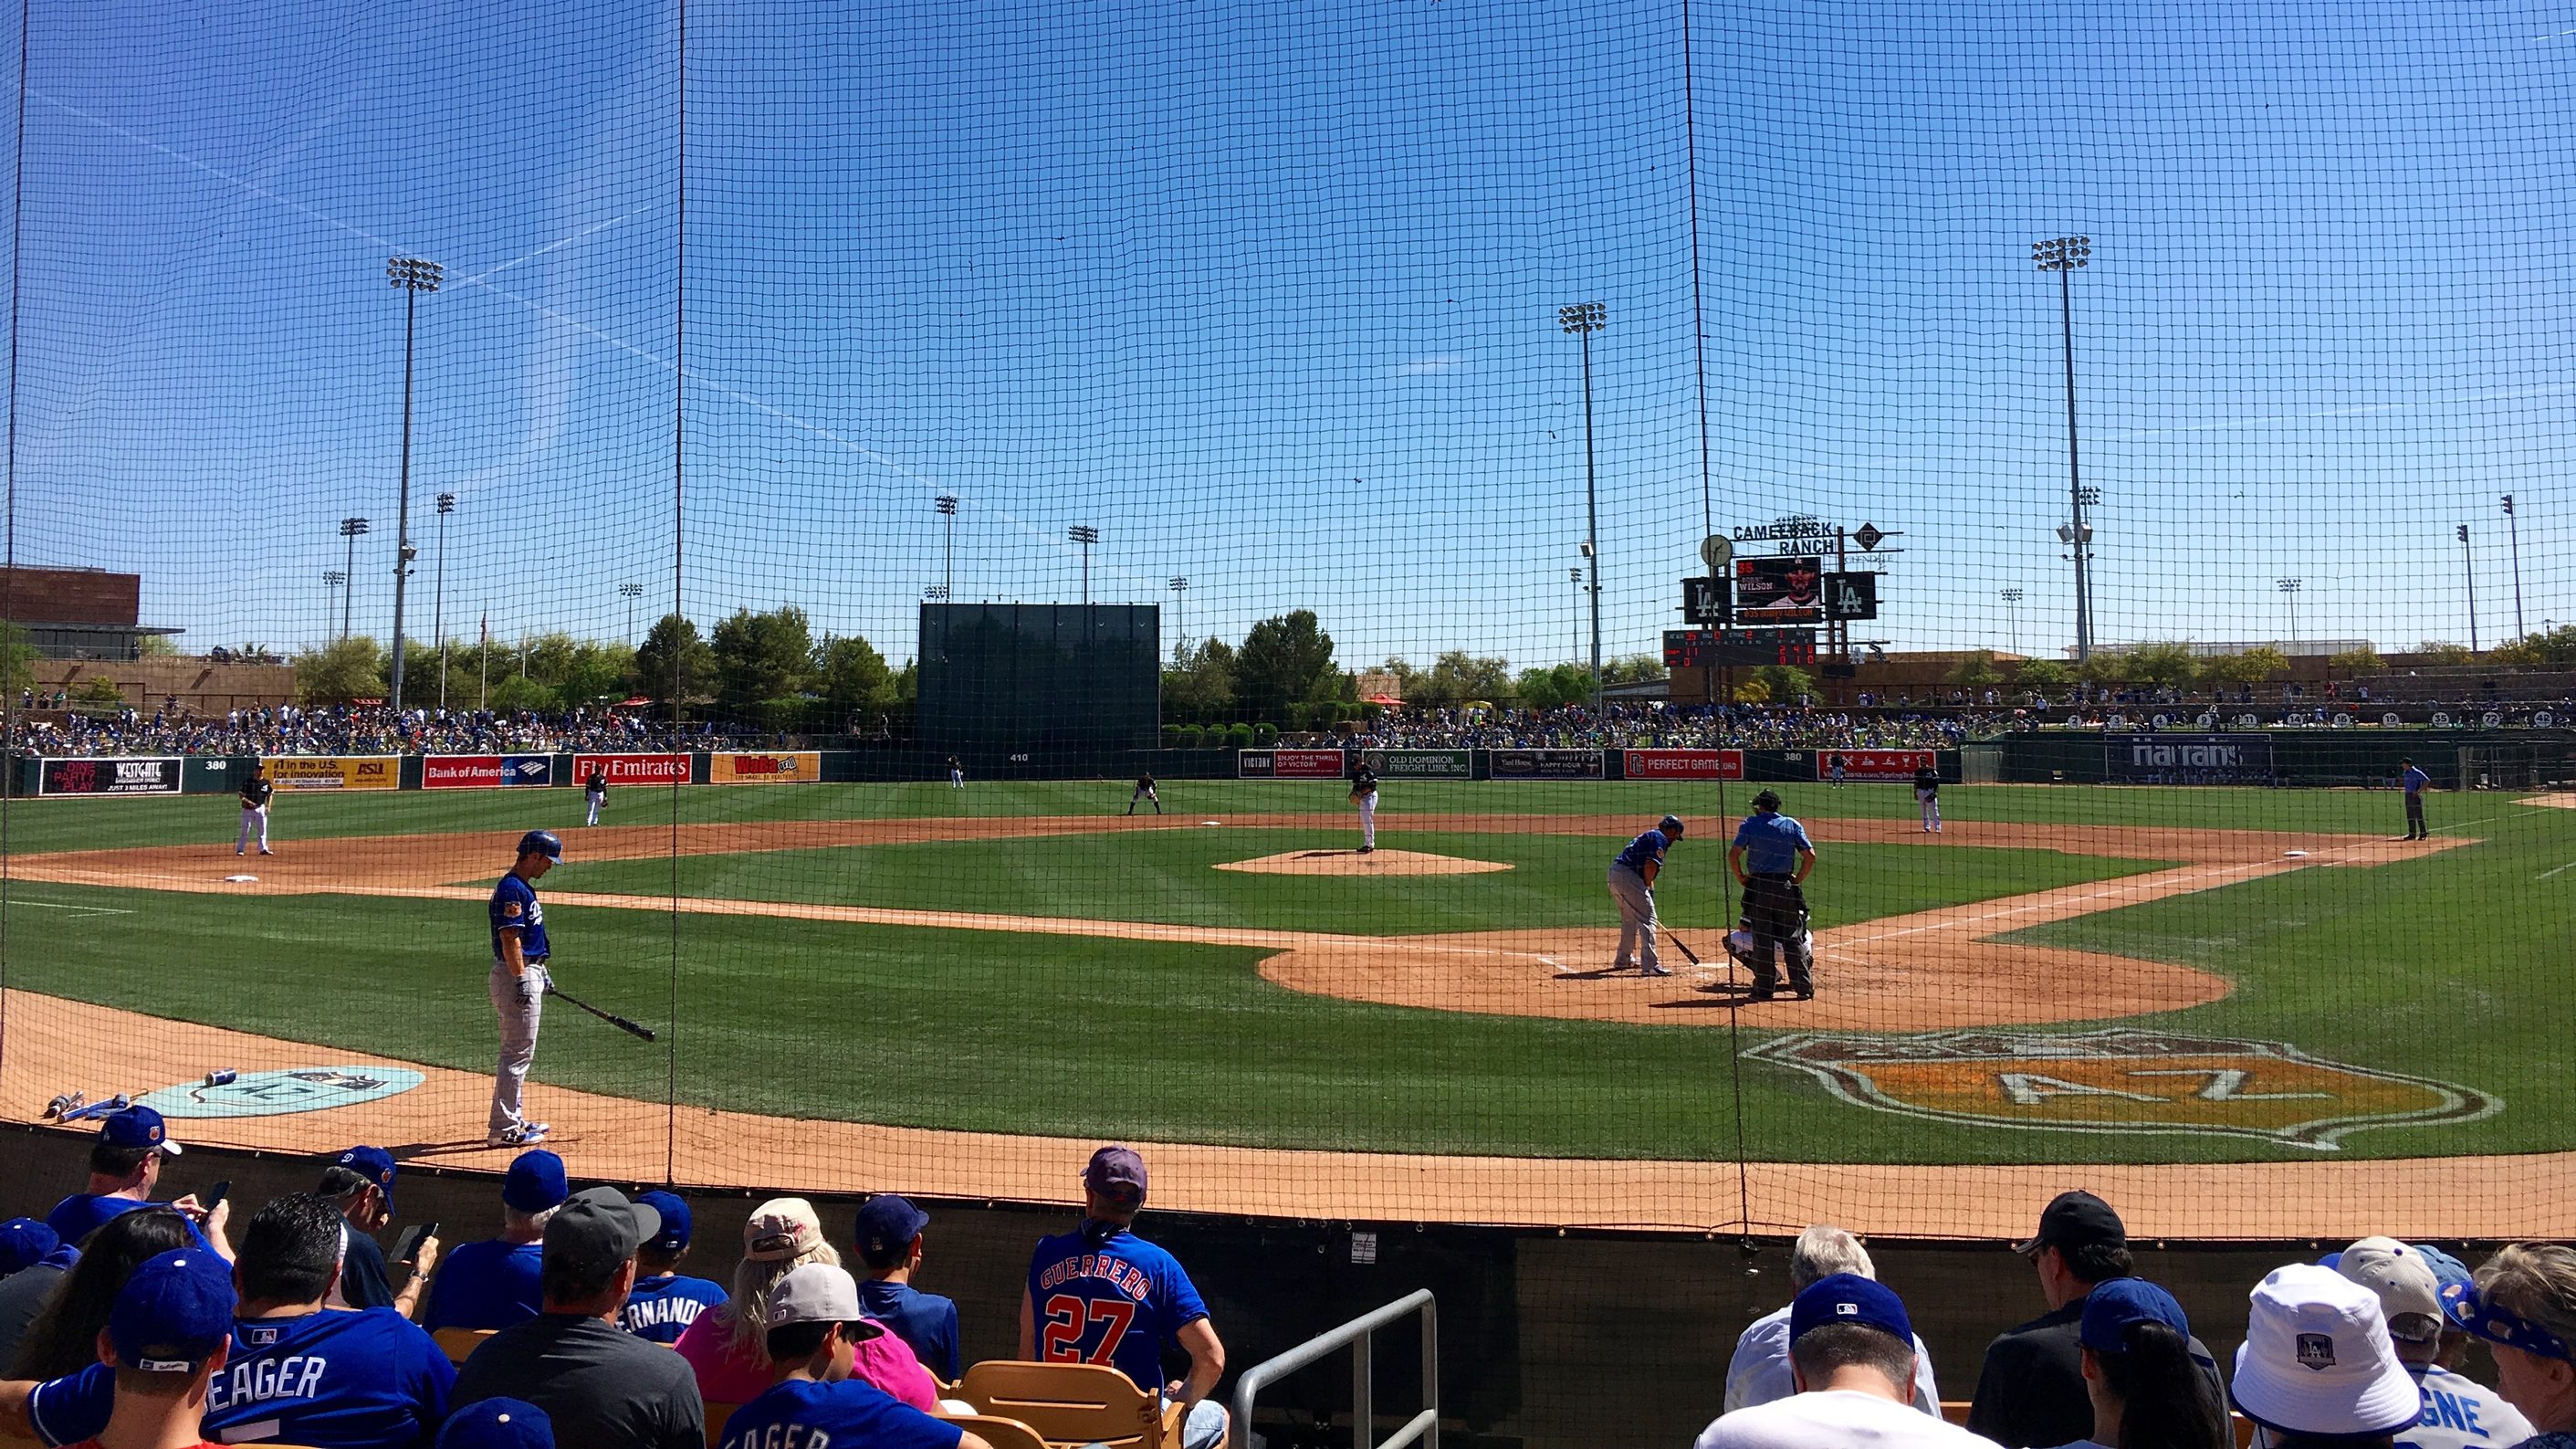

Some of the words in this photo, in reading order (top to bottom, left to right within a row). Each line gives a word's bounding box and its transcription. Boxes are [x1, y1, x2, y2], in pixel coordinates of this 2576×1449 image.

[1734, 522, 1832, 540] CAMELBACK
[1780, 540, 1834, 555] RANCH
[1737, 562, 1754, 573] 35
[1739, 583, 1773, 591] WILSON
[1837, 579, 1861, 613] LA
[1746, 630, 1753, 639] 2
[1780, 646, 1785, 655] 2
[2290, 715, 2302, 724] 14
[2337, 715, 2348, 723] 16
[2385, 715, 2396, 723] 19
[2435, 715, 2446, 723] 35
[2486, 715, 2497, 723] 72
[2538, 715, 2550, 723] 42
[1010, 753, 1028, 761] 410
[1408, 755, 1454, 763] DOMINION
[1784, 752, 1802, 761] 380
[67, 762, 96, 772] DINE
[117, 762, 162, 777] WESTGATE
[205, 761, 226, 770] 380
[288, 761, 296, 769] in
[299, 761, 316, 769] the
[319, 760, 338, 769] U.S.
[357, 763, 383, 774] ASU
[613, 760, 686, 775] Emirates
[735, 756, 778, 774] WaBa
[1389, 764, 1427, 772] FREIGHT
[1450, 764, 1469, 772] INC.
[1648, 760, 1689, 770] PERFECT
[54, 771, 96, 782] PARTY
[274, 770, 288, 778] for
[291, 769, 344, 778] innovation
[429, 767, 456, 778] Bank
[458, 767, 469, 777] of
[471, 766, 516, 777] America
[63, 781, 93, 792] PLAY
[1996, 1068, 2335, 1106] AZ
[341, 1153, 354, 1163] D
[1041, 1255, 1151, 1301] GUERRERO
[1043, 1294, 1136, 1368] 27
[2309, 1341, 2321, 1358] LA
[204, 1357, 327, 1414] EAGER
[725, 1423, 831, 1449] AGER
